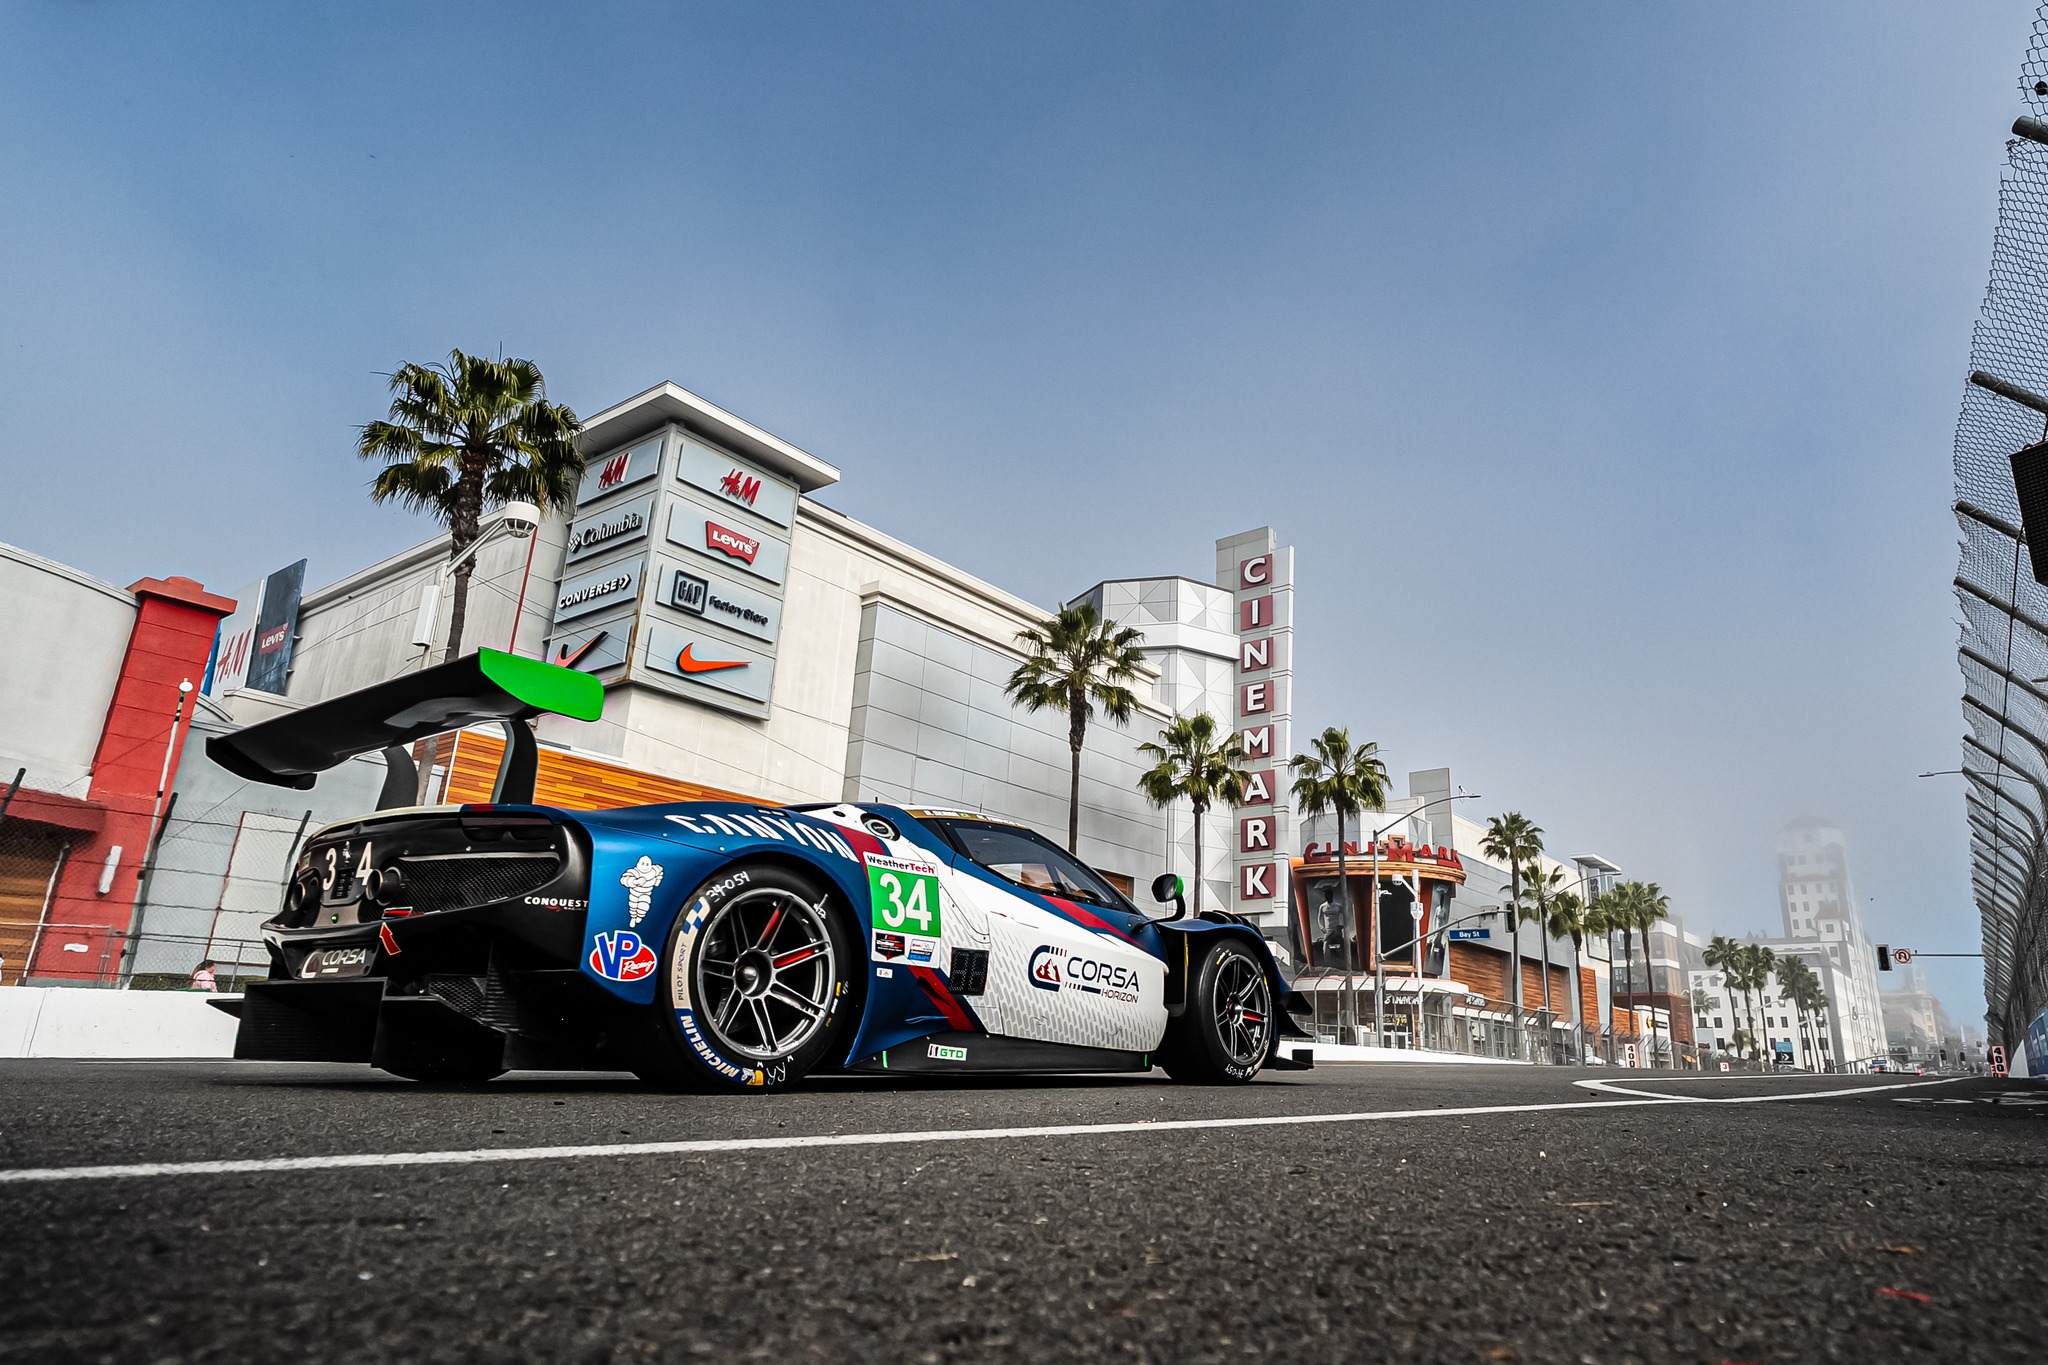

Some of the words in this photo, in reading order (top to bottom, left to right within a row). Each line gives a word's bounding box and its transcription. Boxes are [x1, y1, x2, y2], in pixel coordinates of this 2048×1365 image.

[721, 468, 761, 505] H&M
[581, 513, 643, 546] Columbia
[559, 578, 618, 608] CONVERSE
[678, 580, 703, 606] GAP
[709, 595, 743, 617] Factory
[743, 608, 768, 626] Store
[1243, 557, 1270, 897] CINEMARK
[664, 813, 860, 864] CANYON
[323, 848, 337, 890] 3
[355, 841, 373, 886] 4
[867, 855, 935, 875] WeatherTech
[524, 896, 589, 908] CONQUEST
[880, 873, 932, 931] 34
[322, 949, 367, 966] CORSA
[595, 931, 640, 979] VP
[622, 960, 656, 975] Racing
[677, 942, 687, 971] SPORT
[677, 971, 685, 1000] PILOT
[1066, 957, 1140, 992] CORSA
[1101, 988, 1138, 1004] HORIZON
[680, 1015, 740, 1078] MICHELIN
[940, 1048, 964, 1058] GTD
[1627, 1045, 1636, 1068] 400
[1994, 1047, 2005, 1072] 400
